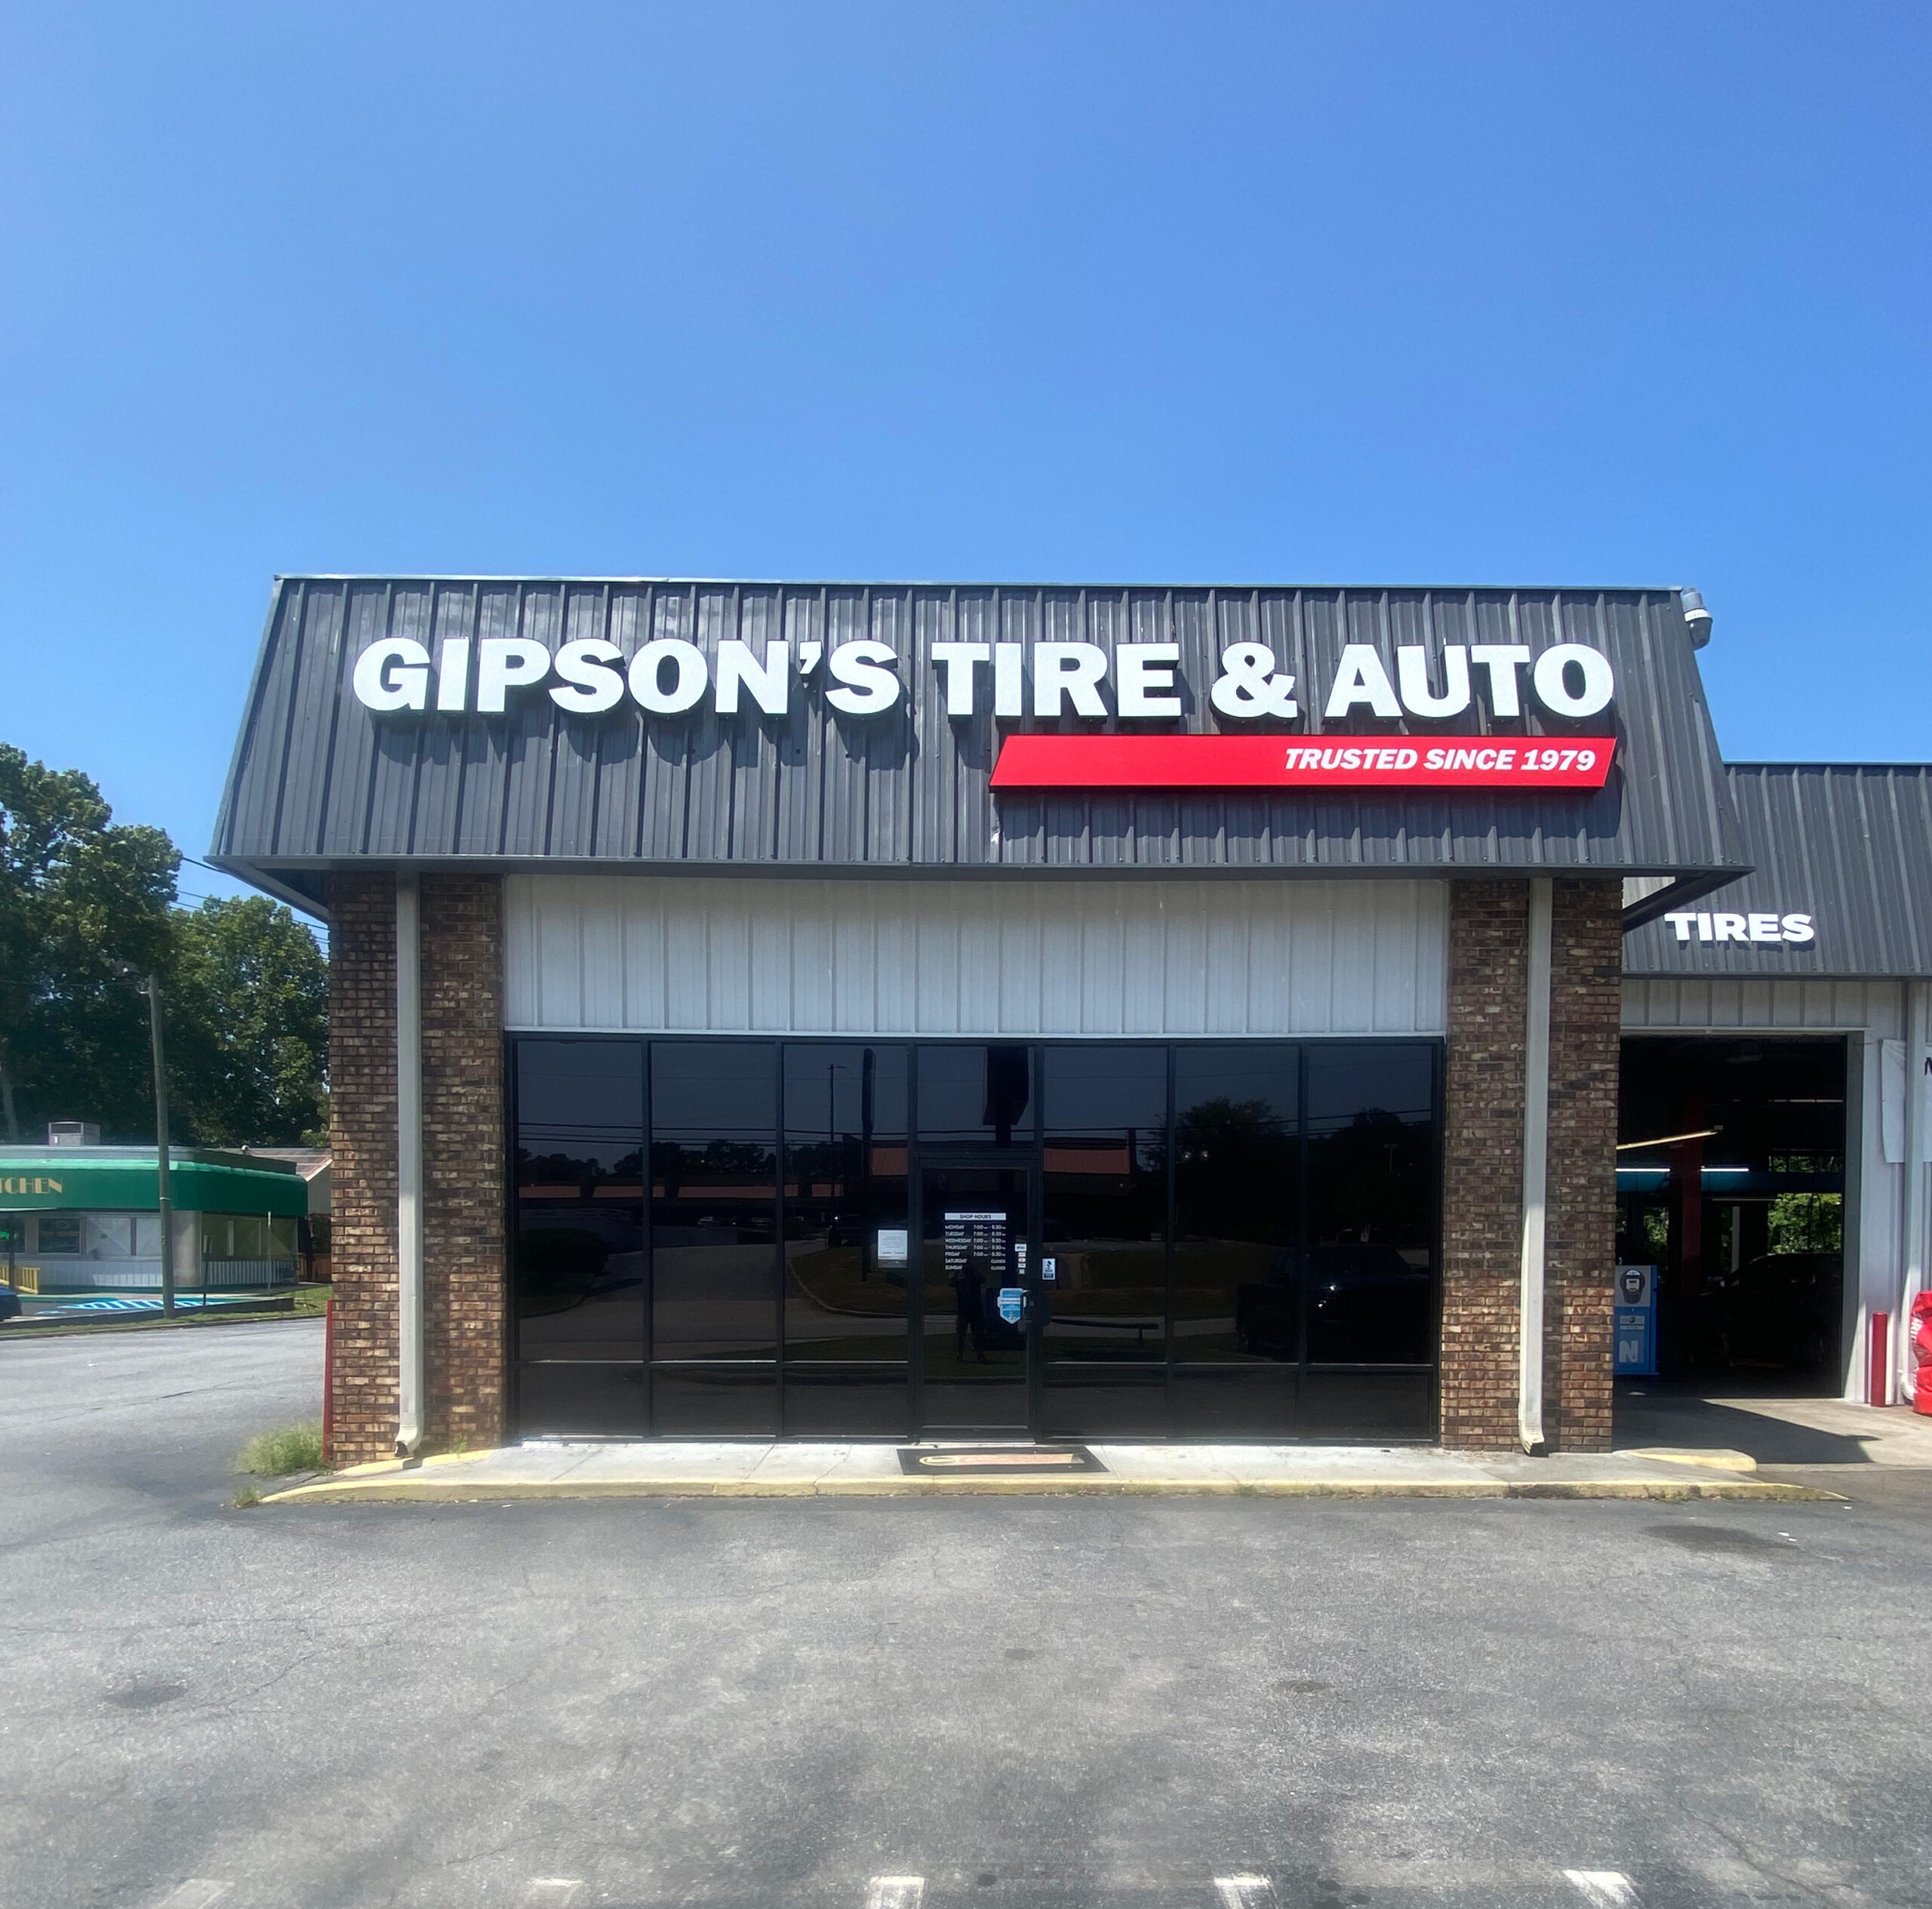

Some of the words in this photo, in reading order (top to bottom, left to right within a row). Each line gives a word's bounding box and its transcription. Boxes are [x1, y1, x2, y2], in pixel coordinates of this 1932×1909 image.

[352, 637, 900, 715] GIPSON'S
[931, 641, 1183, 717] TIRE
[1211, 641, 1298, 718] &
[1324, 643, 1615, 718] AUTO
[1284, 748, 1419, 770] TRUSTED
[1423, 749, 1516, 770] SINCE
[1521, 749, 1596, 770] 1979
[1664, 912, 1815, 942] TIRES
